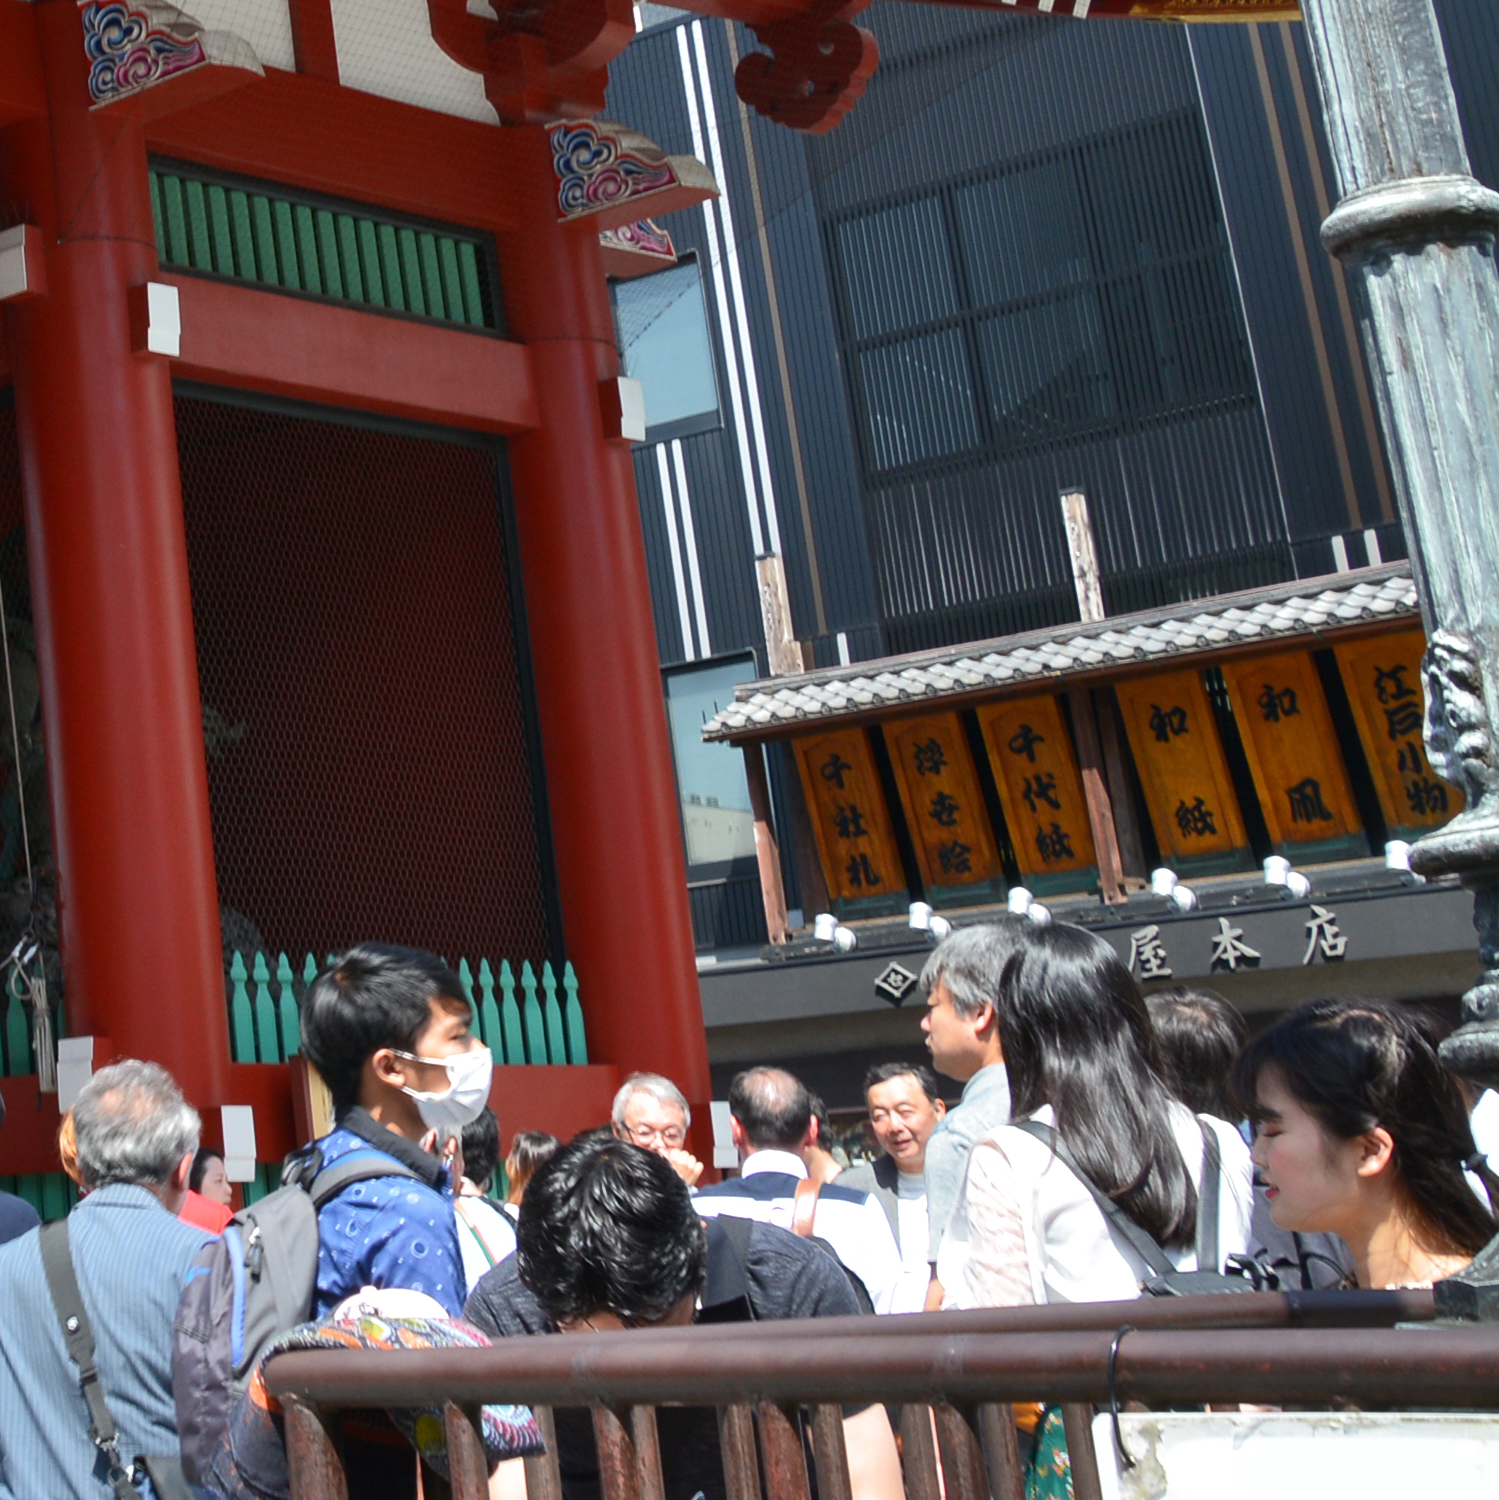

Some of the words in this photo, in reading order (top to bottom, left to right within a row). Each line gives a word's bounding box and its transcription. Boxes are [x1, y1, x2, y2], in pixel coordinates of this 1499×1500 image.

[820, 753, 880, 887] 千社札
[913, 737, 972, 875] 浮世絵
[1009, 724, 1075, 864] 千代紙
[1149, 704, 1218, 839] 和紙
[1129, 904, 1347, 980] 屋本店
